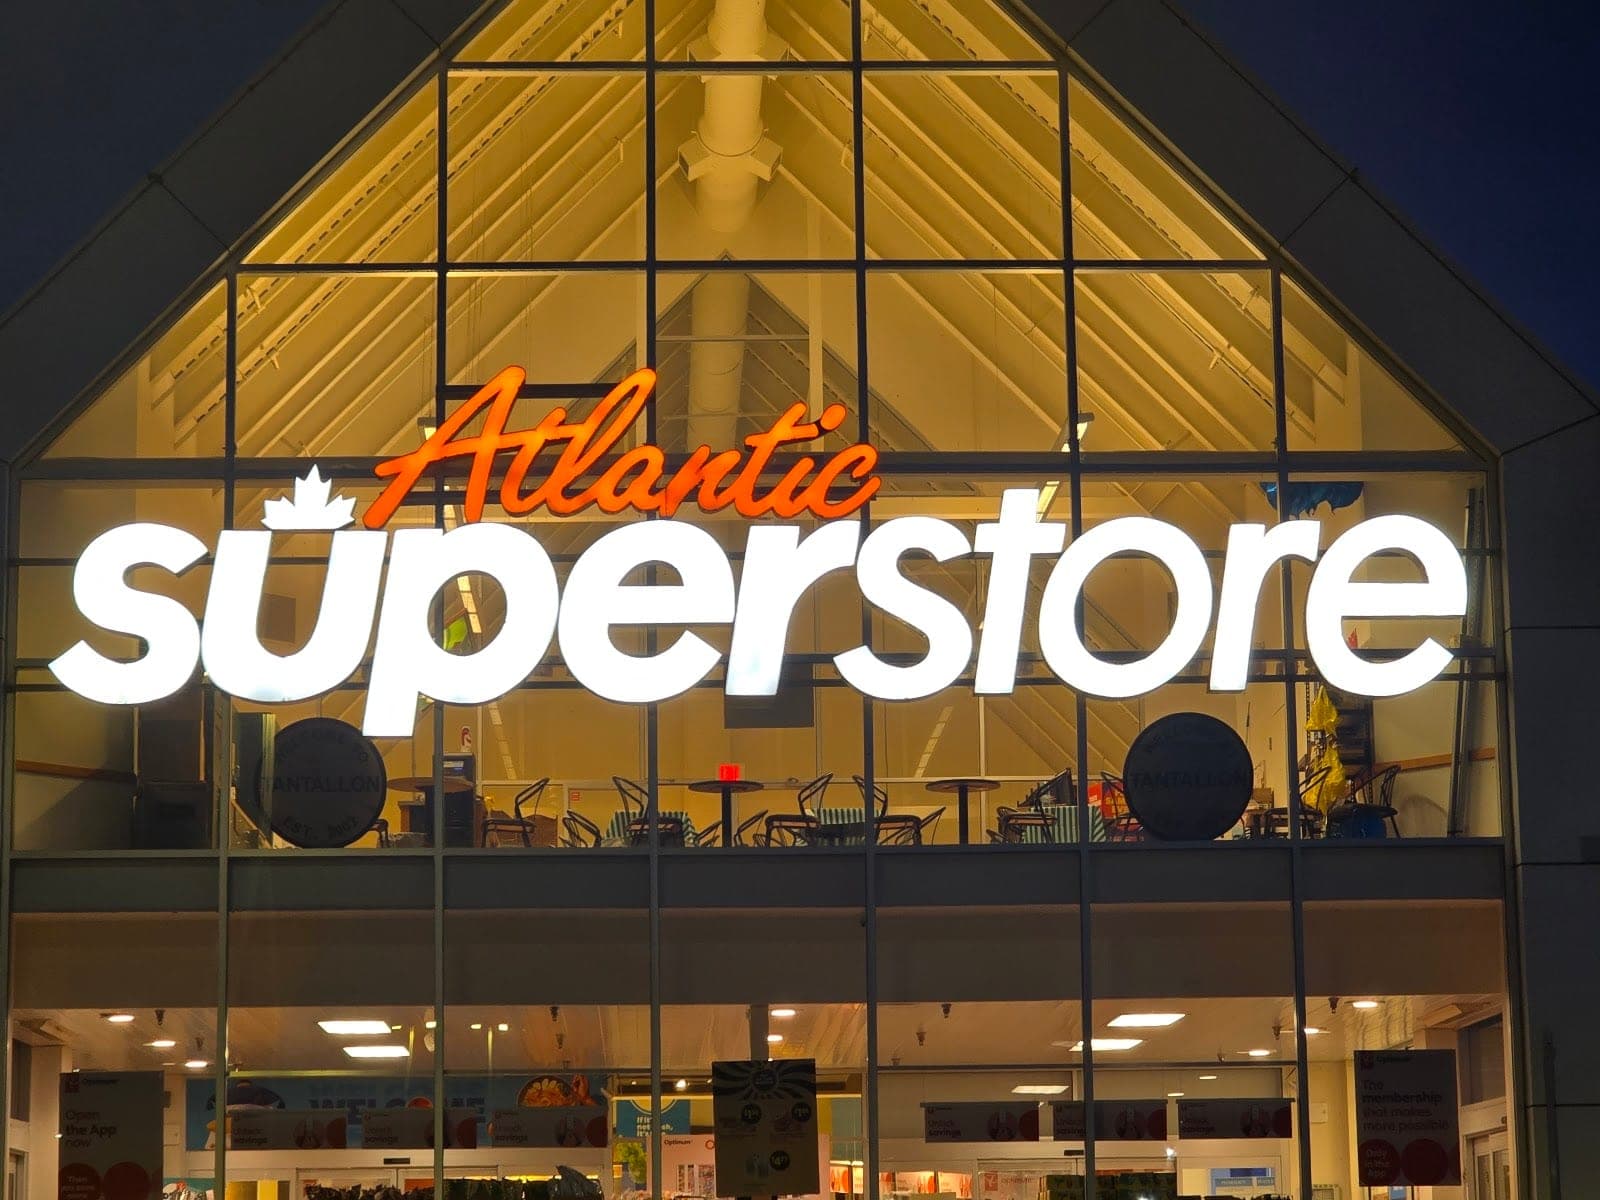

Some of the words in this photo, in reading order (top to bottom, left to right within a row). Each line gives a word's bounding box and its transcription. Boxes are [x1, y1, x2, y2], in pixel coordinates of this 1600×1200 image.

[362, 365, 881, 528] Atlantic
[48, 487, 1468, 736] superstore
[1363, 1080, 1384, 1091] The
[1362, 1091, 1443, 1107] membership
[65, 1110, 100, 1124] Open
[65, 1124, 88, 1136] the
[89, 1124, 117, 1138] App
[1399, 1120, 1449, 1134] possible
[65, 1140, 91, 1148] now
[663, 1139, 692, 1147] Optimum
